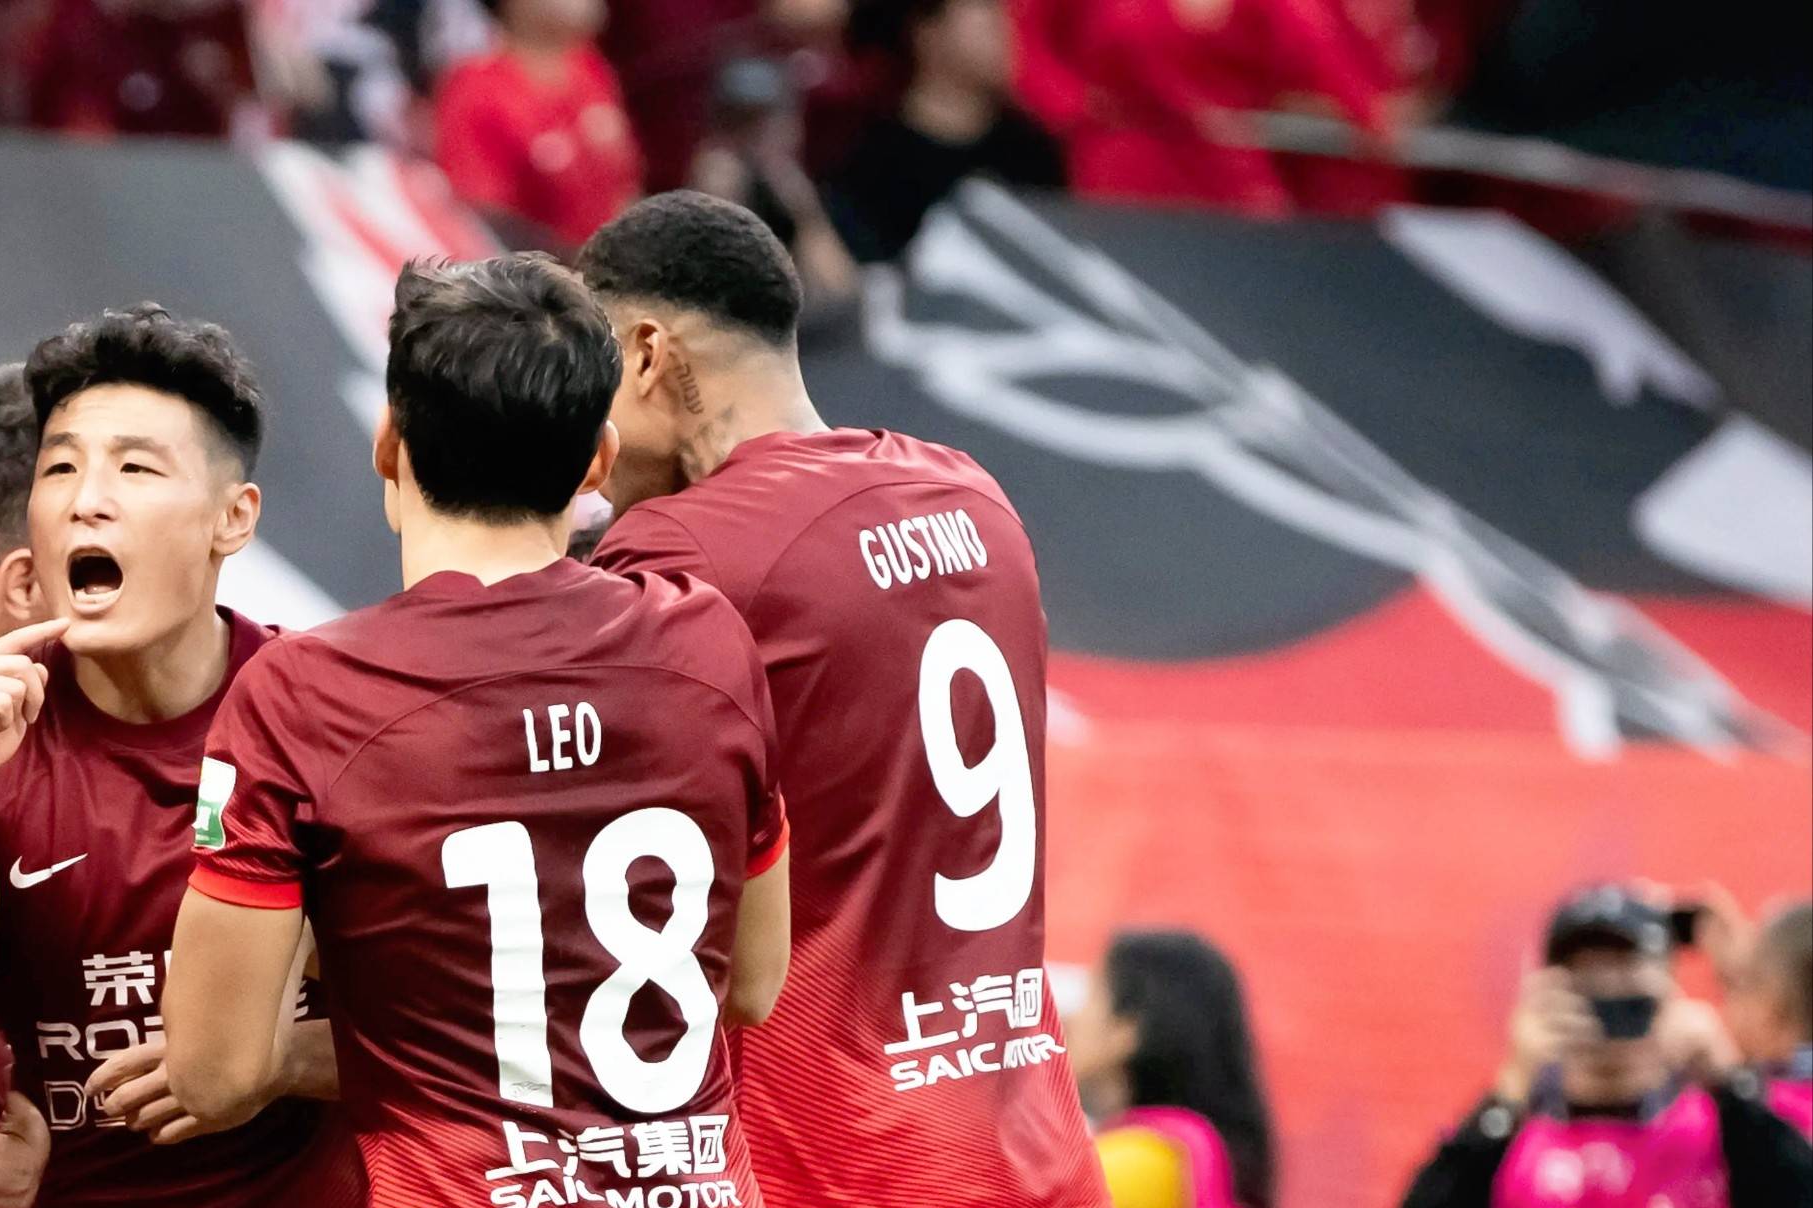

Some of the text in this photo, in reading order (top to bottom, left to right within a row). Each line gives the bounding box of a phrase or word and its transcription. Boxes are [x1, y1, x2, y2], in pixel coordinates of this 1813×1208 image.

[859, 508, 987, 590] GUSTAVO
[523, 701, 602, 773] LEO
[918, 618, 1036, 932] 9
[441, 807, 719, 1114] 18
[889, 1042, 1003, 1093] SAIC
[485, 1114, 730, 1182] 上汽集团
